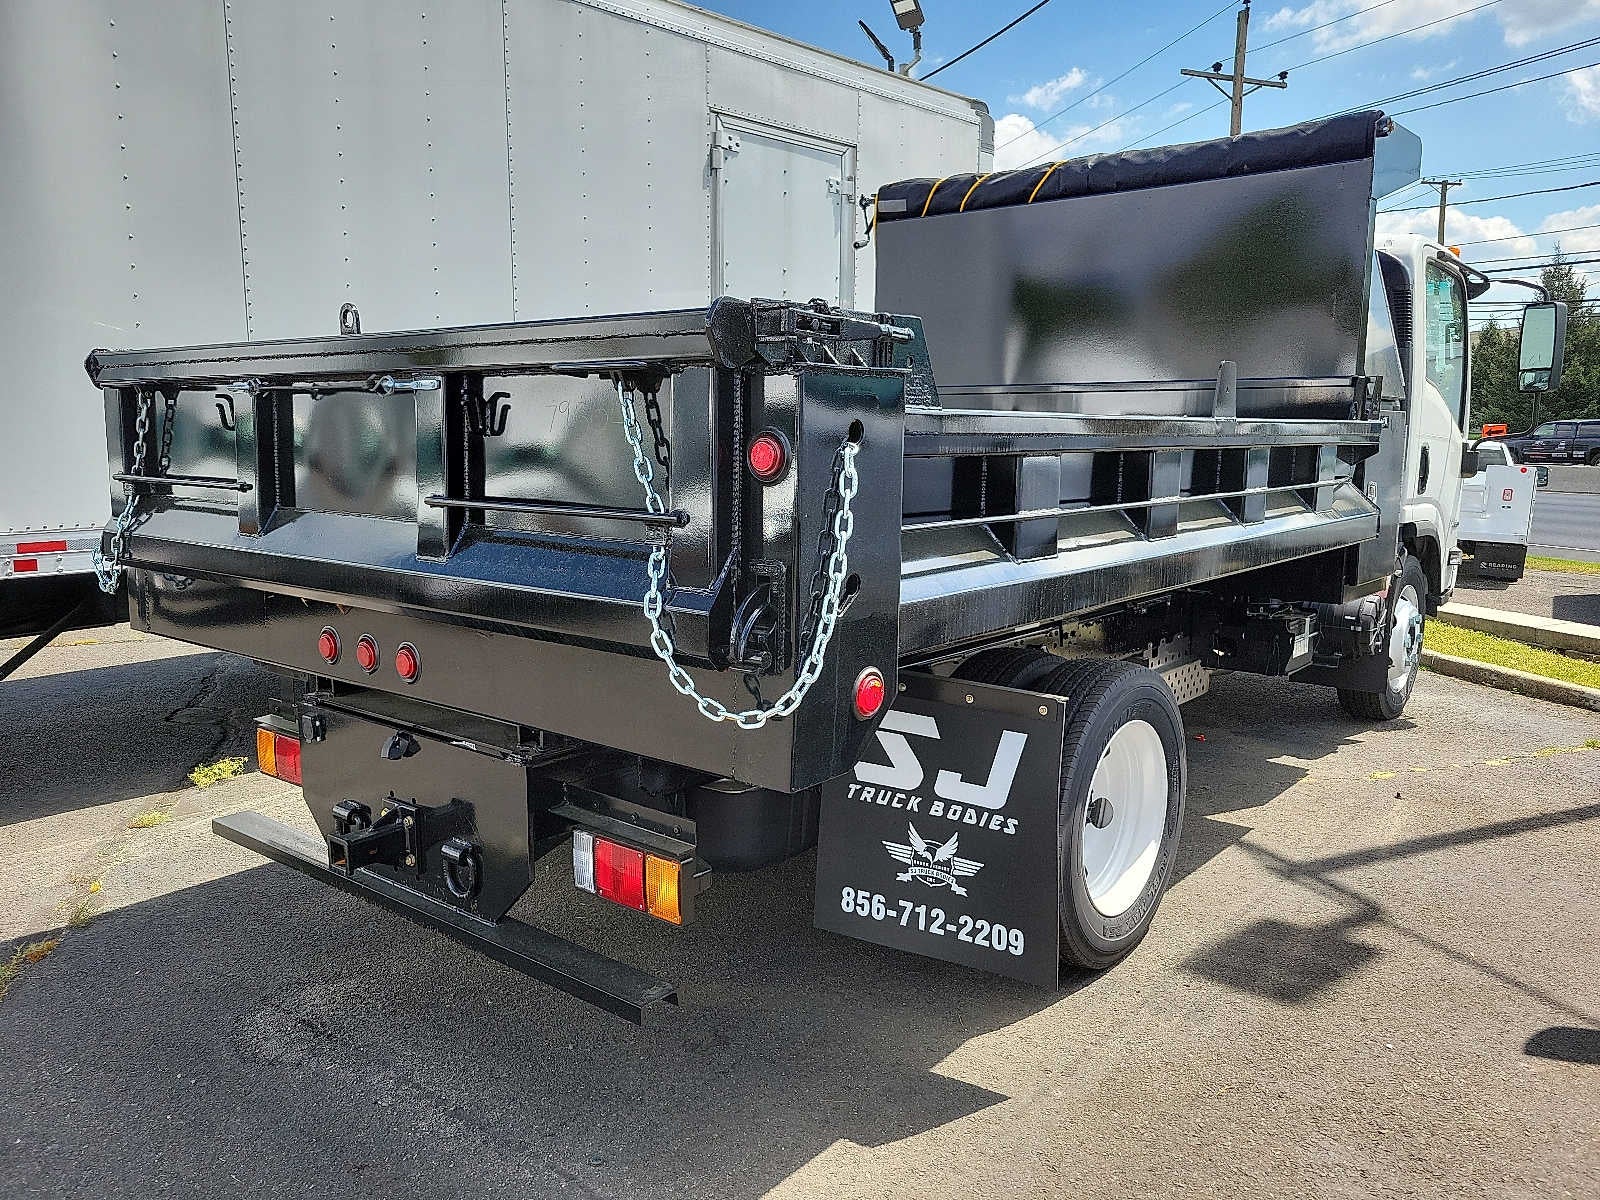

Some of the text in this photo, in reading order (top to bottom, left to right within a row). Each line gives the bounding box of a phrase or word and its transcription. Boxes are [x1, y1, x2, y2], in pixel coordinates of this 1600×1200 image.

[853, 709, 1028, 809] SJ
[847, 783, 1018, 835] TRUCK BODIES
[841, 886, 1025, 956] 856-712-2209
